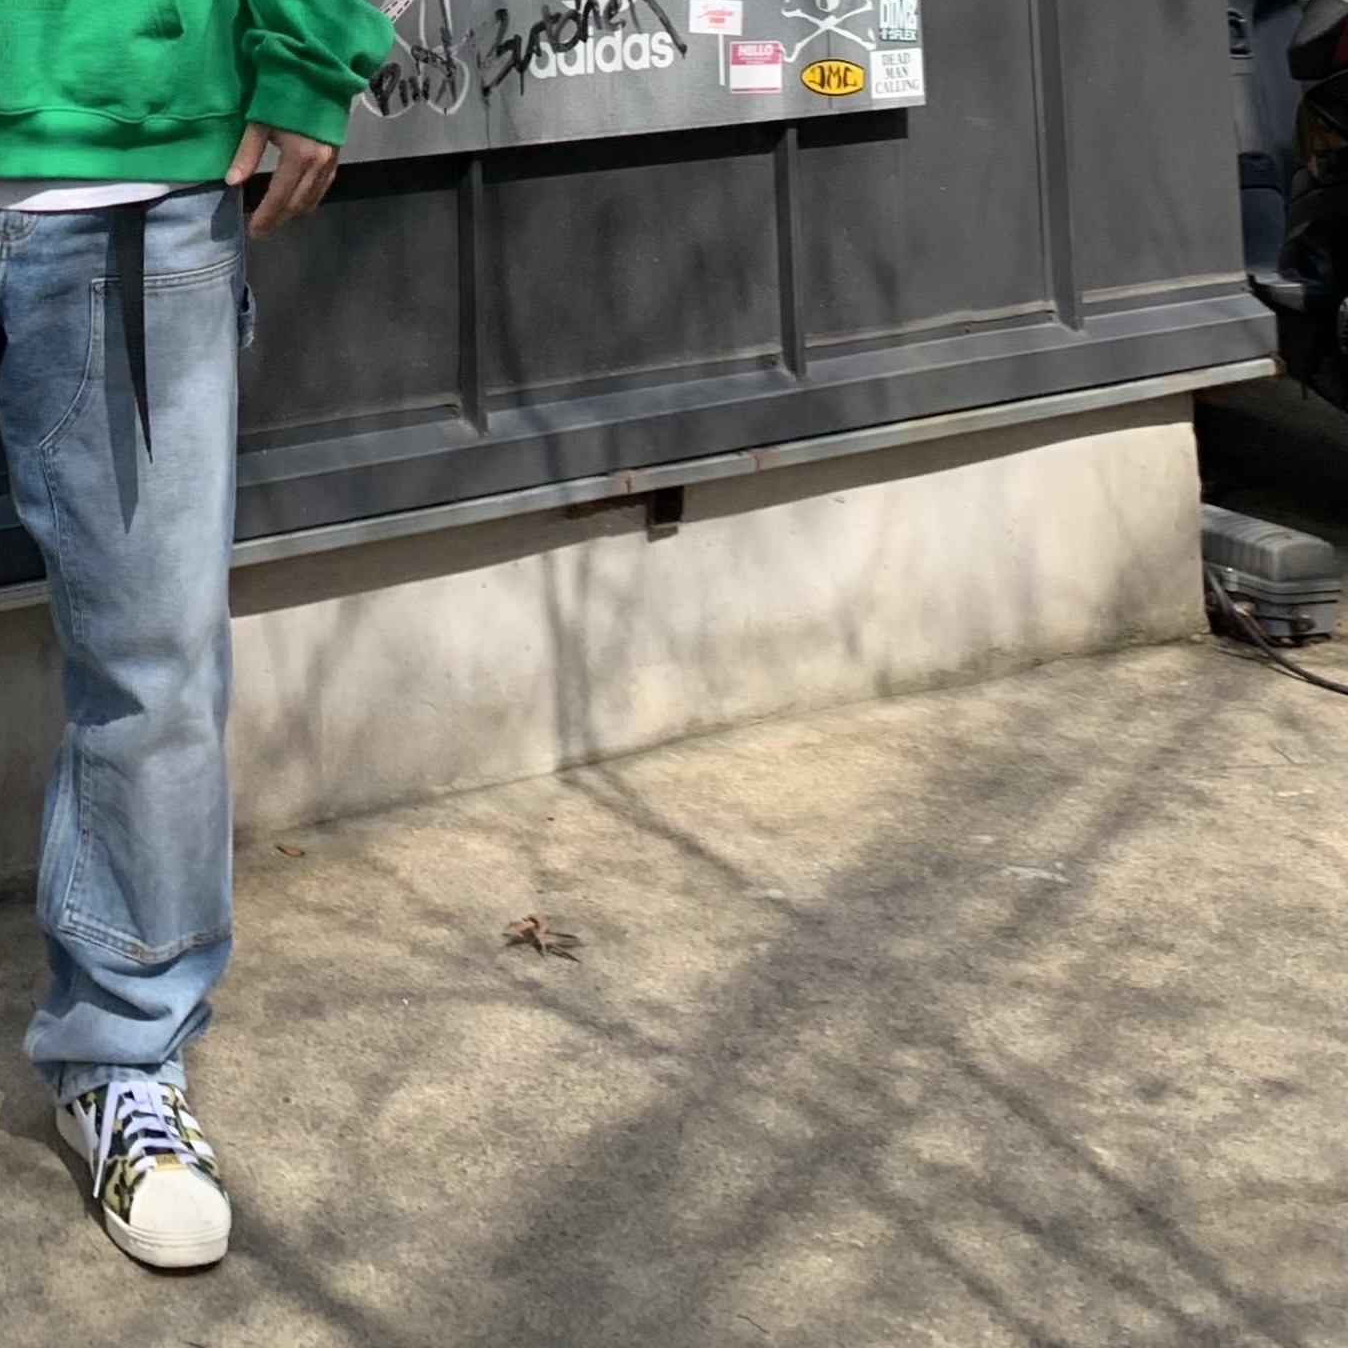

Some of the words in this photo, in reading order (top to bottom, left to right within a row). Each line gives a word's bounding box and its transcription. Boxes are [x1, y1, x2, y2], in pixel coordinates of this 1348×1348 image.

[529, 26, 675, 80] adidas
[737, 43, 774, 57] HELLO
[881, 54, 911, 67] DEAD
[884, 67, 909, 79] MAN
[875, 79, 920, 95] CALLING
